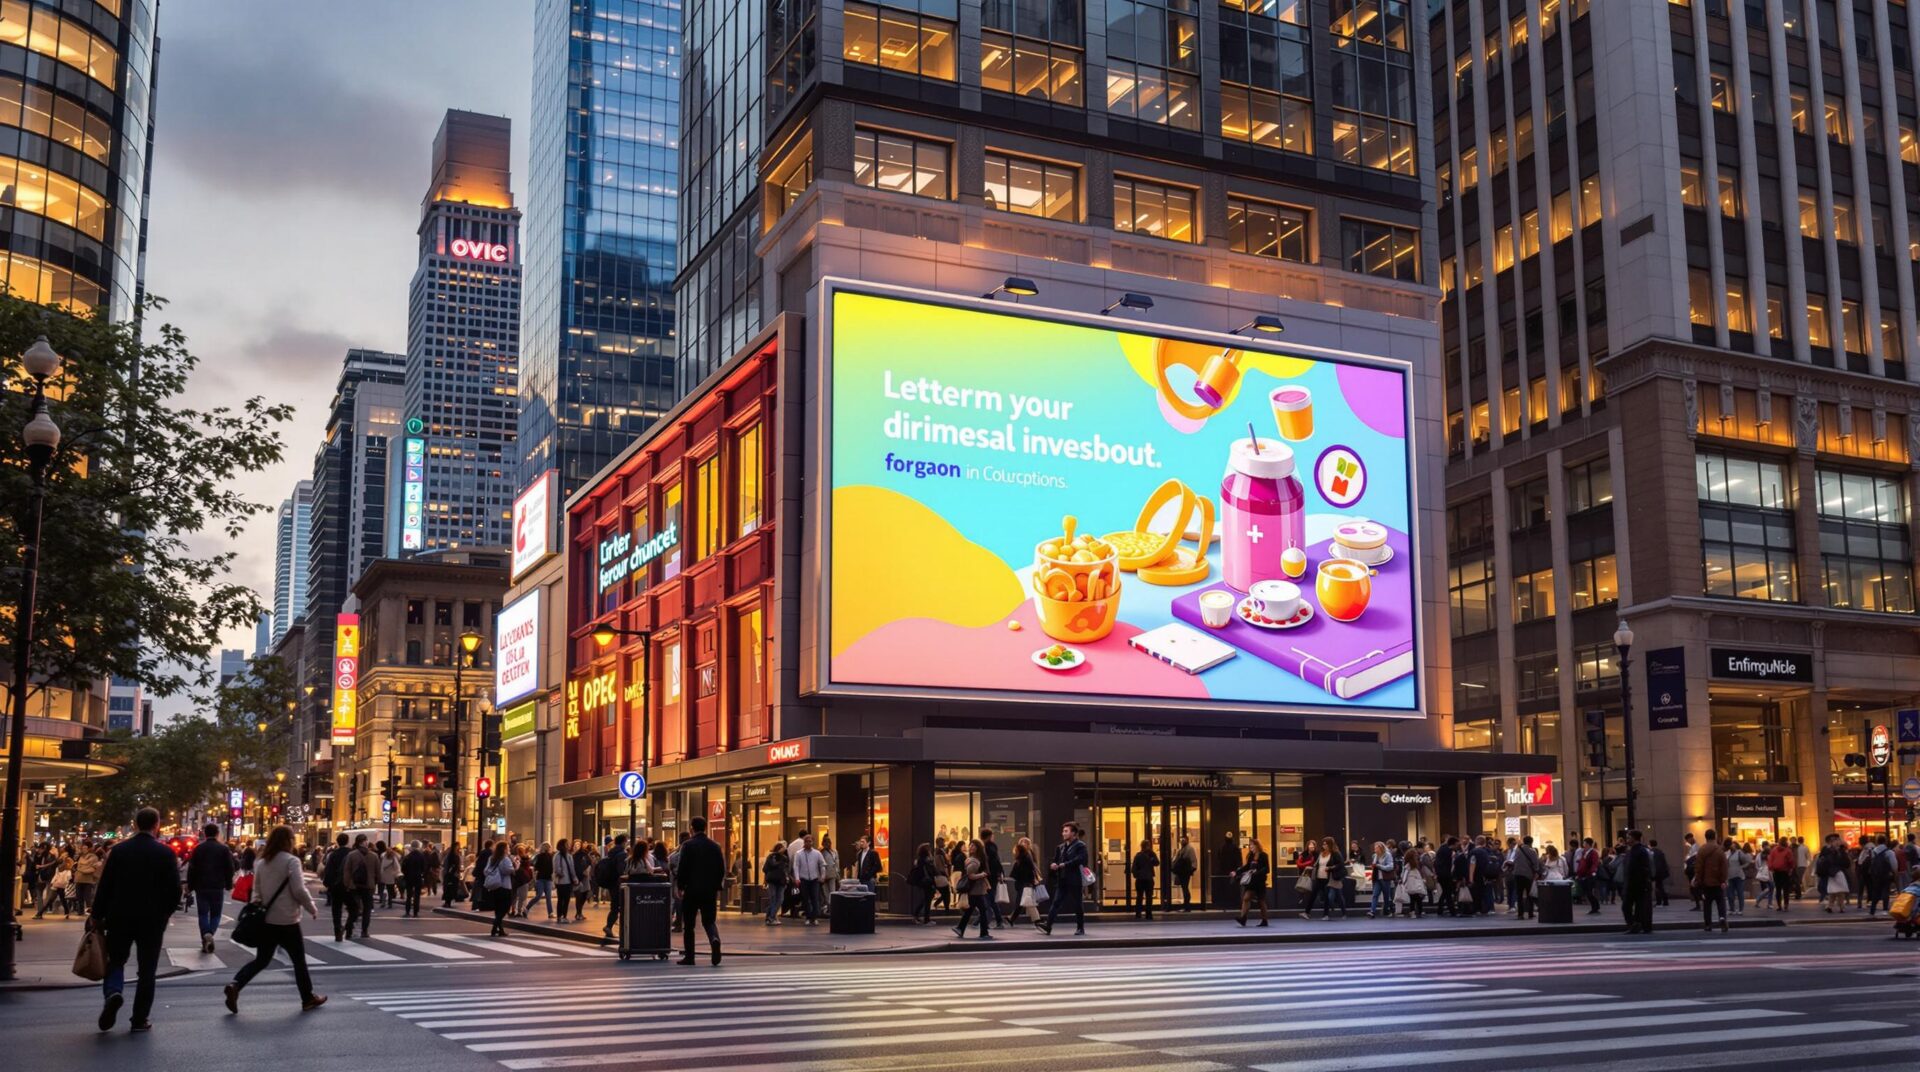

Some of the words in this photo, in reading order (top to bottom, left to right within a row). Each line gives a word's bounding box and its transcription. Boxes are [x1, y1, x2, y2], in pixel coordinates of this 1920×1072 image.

[451, 238, 508, 262] OVIC
[884, 370, 1002, 412] Letterm
[1009, 392, 1073, 421] your
[883, 410, 1016, 453] dirimesal
[1023, 427, 1163, 468] invesbout.
[885, 453, 961, 479] forgaon
[966, 463, 979, 481] in
